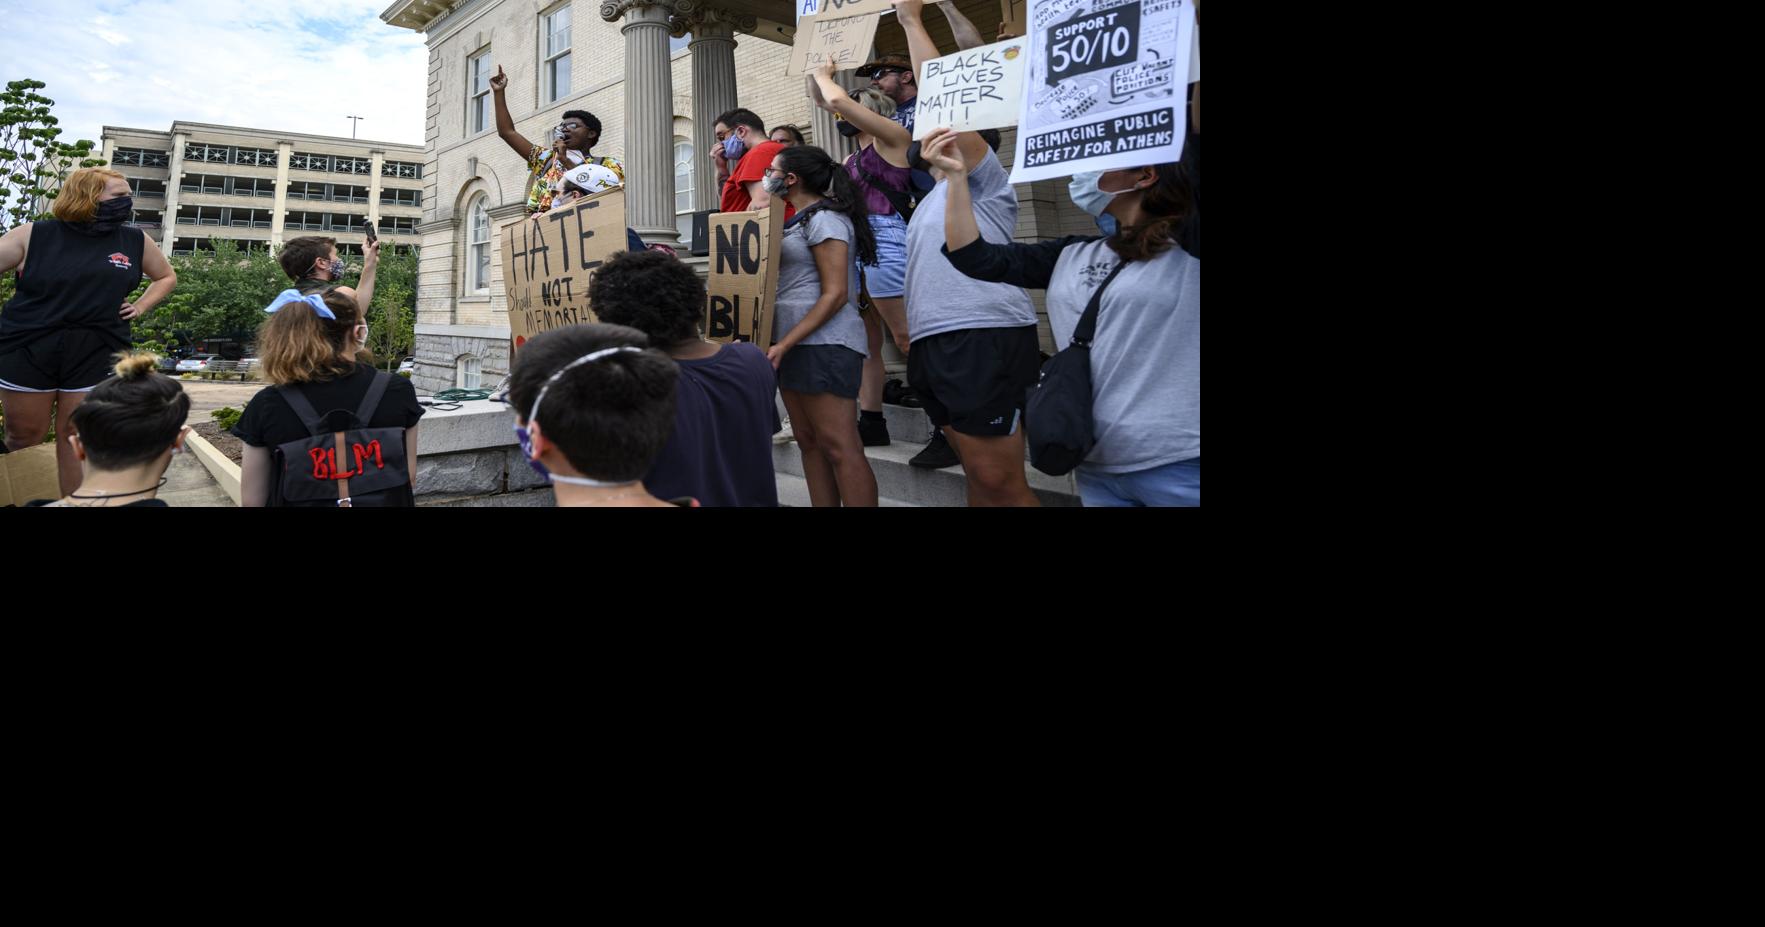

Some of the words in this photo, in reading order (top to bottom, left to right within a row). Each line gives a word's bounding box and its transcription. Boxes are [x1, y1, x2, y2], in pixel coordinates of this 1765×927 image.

[823, 31, 844, 46] THE
[1055, 13, 1118, 40] SUPPORT
[926, 50, 1000, 80] BLACK
[1052, 26, 1130, 73] 50/10
[943, 66, 1004, 88] LIVES
[1115, 65, 1137, 78] CUT
[1115, 70, 1151, 85] POLICE
[918, 85, 1004, 115] MATTER
[1027, 123, 1106, 151] REIMAGINE
[1114, 110, 1170, 134] PUBLIC
[1026, 145, 1081, 166] SAFETY
[1084, 139, 1112, 157] FOR
[1116, 130, 1173, 151] ATHENS
[510, 200, 603, 286] HATE
[716, 219, 761, 275] NO
[509, 286, 533, 312] Shall
[541, 276, 573, 307] NOT
[308, 439, 385, 481] BLM
